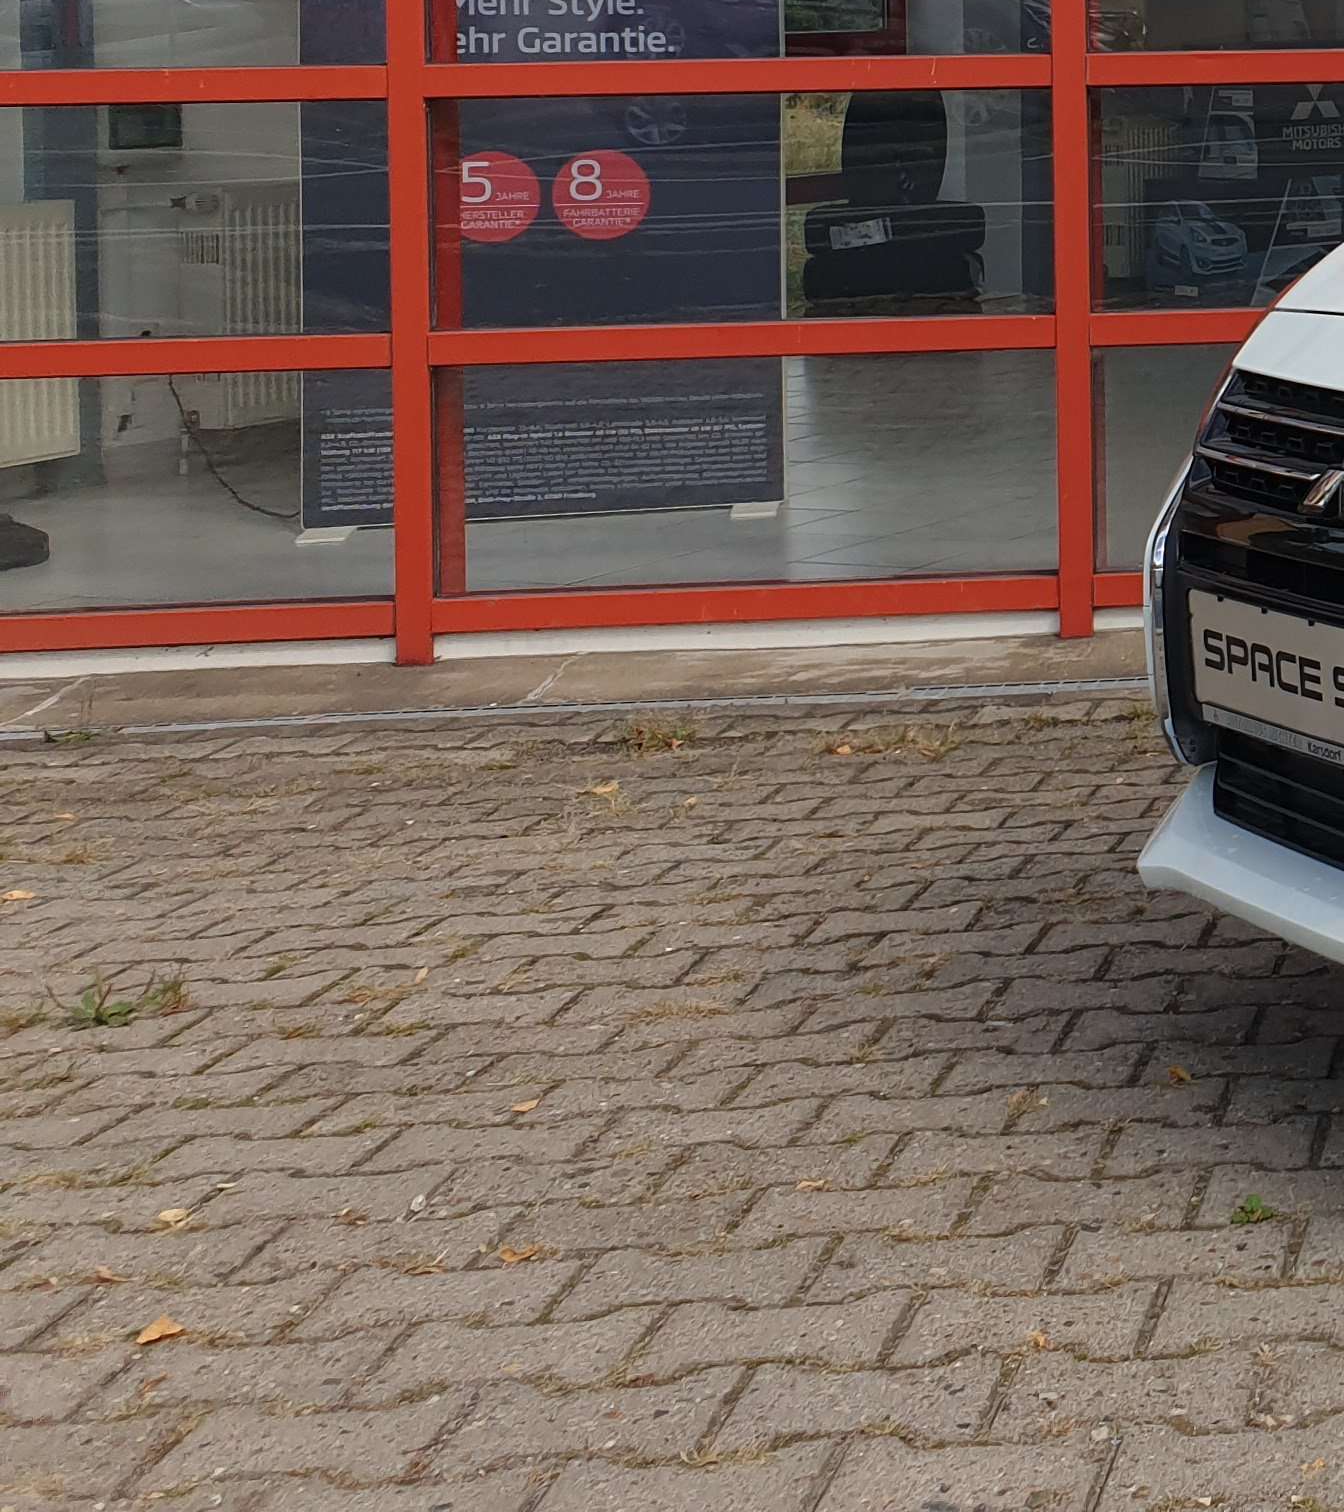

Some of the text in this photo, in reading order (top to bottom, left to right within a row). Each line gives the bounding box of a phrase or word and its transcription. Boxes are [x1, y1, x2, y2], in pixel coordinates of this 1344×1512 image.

[456, 25, 676, 54] ehr Garantie.
[1292, 137, 1342, 151] MOTORS
[461, 161, 529, 203] 5 JAHRE
[569, 159, 640, 201] 8 JAHRE
[1203, 628, 1323, 703] SPACE
